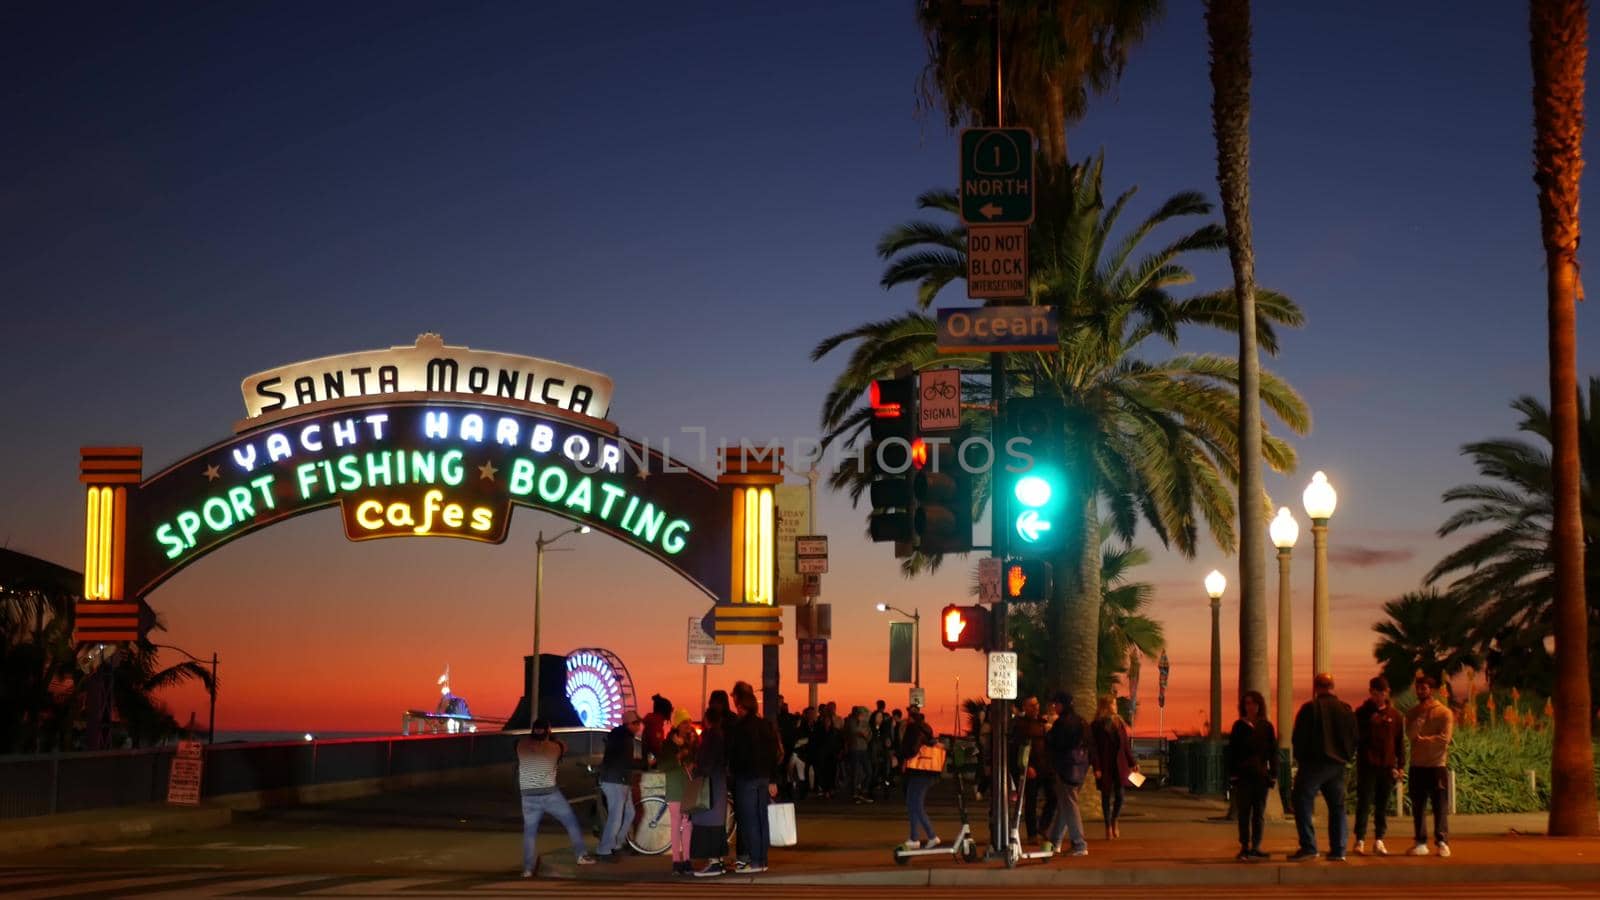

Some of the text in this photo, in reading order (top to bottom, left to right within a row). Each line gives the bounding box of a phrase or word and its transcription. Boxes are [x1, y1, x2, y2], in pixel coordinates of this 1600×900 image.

[966, 179, 1028, 196] NORTH
[971, 235, 1024, 251] DO NOT
[971, 258, 1024, 276] BLOCK
[971, 280, 1025, 292] INTERSECTION
[947, 312, 1049, 337] Ocean
[256, 357, 594, 415] SANTA MONICA
[923, 407, 957, 420] SIGNAL
[233, 411, 621, 474] YACHT HARBOR
[155, 450, 692, 560] SPORT FISHING BOATING
